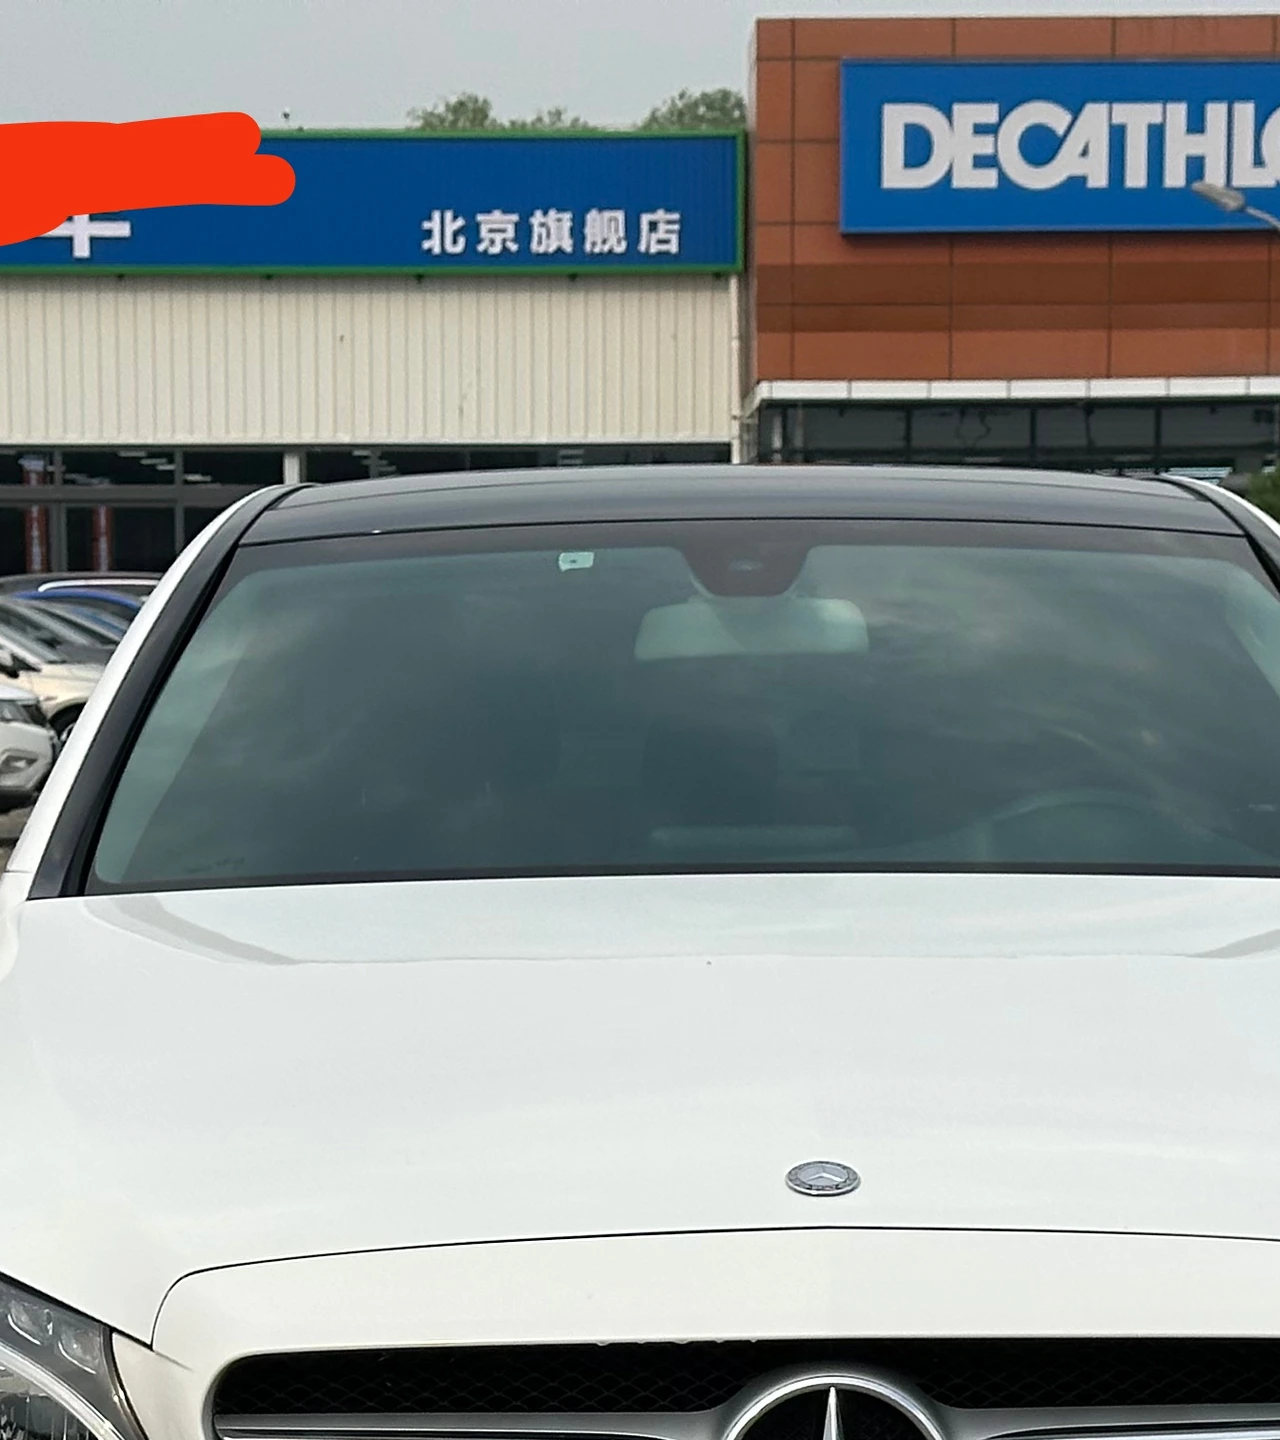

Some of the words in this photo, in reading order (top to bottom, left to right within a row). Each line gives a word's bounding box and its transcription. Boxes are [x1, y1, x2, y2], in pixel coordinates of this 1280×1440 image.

[421, 208, 681, 255] 北京旗舰店
